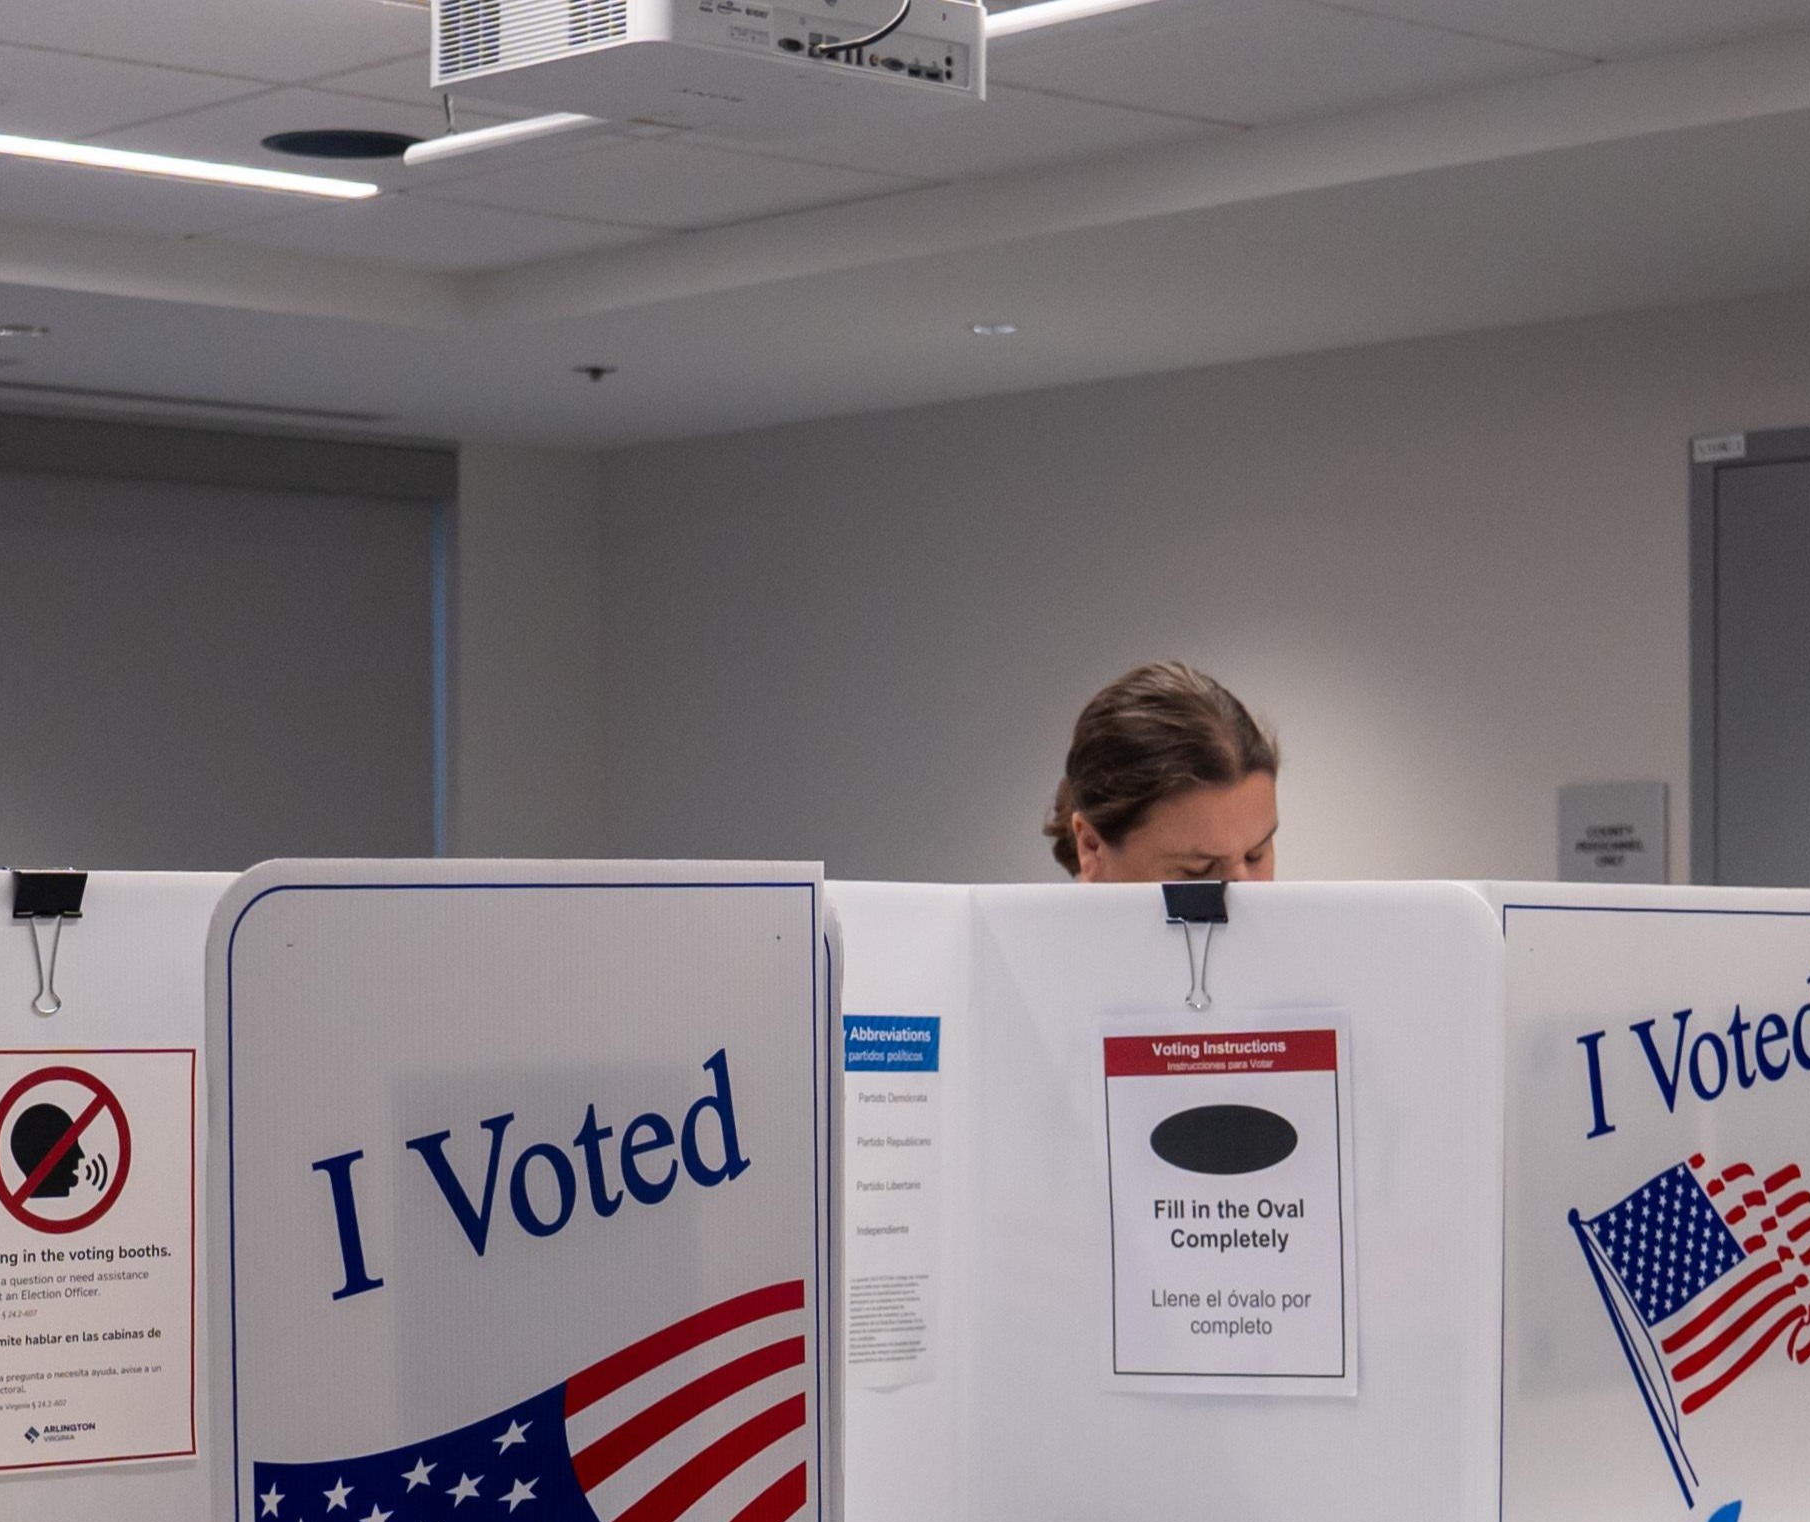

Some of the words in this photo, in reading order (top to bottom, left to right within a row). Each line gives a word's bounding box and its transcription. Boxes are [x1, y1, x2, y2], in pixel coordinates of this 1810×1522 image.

[850, 1026, 931, 1042] Abbreviations
[848, 1050, 885, 1063] partidos
[1152, 1042, 1199, 1058] Voting
[1203, 1039, 1286, 1054] Instructions
[1167, 1060, 1226, 1071] Instrucciones
[1228, 1061, 1248, 1071] para
[1249, 1059, 1273, 1069] Votar
[1576, 1030, 1617, 1140] I
[311, 1149, 385, 1302] I
[405, 1047, 752, 1258] Voted
[1154, 1199, 1185, 1219] Fill
[1192, 1200, 1210, 1219] in
[1218, 1199, 1250, 1219] the
[1257, 1198, 1305, 1219] Oval
[1170, 1228, 1289, 1253] Completely
[23, 1249, 37, 1263] in
[41, 1249, 65, 1263] the
[69, 1247, 114, 1262] voting
[118, 1244, 172, 1259] booths.
[0, 1279, 7, 1287] a
[10, 1274, 54, 1288] question
[56, 1275, 67, 1284] or
[69, 1272, 95, 1283] need
[97, 1270, 149, 1281] assistance
[5, 1292, 18, 1301] an
[21, 1289, 62, 1300] Election
[64, 1287, 101, 1299] Officer.
[1151, 1289, 1200, 1307] Llene
[1206, 1290, 1221, 1307] el
[1228, 1289, 1276, 1308] óvalo
[1282, 1293, 1311, 1311] por
[25, 1333, 62, 1346] hablar
[65, 1333, 79, 1343] en
[82, 1330, 99, 1342] las
[102, 1328, 144, 1341] cabinas
[147, 1327, 162, 1339] de
[1190, 1317, 1273, 1338] completo
[6, 1370, 45, 1383] pregunta
[54, 1368, 89, 1379] necesita
[121, 1365, 143, 1375] avise
[151, 1364, 162, 1373] un
[43, 1423, 96, 1434] ARLINGTON
